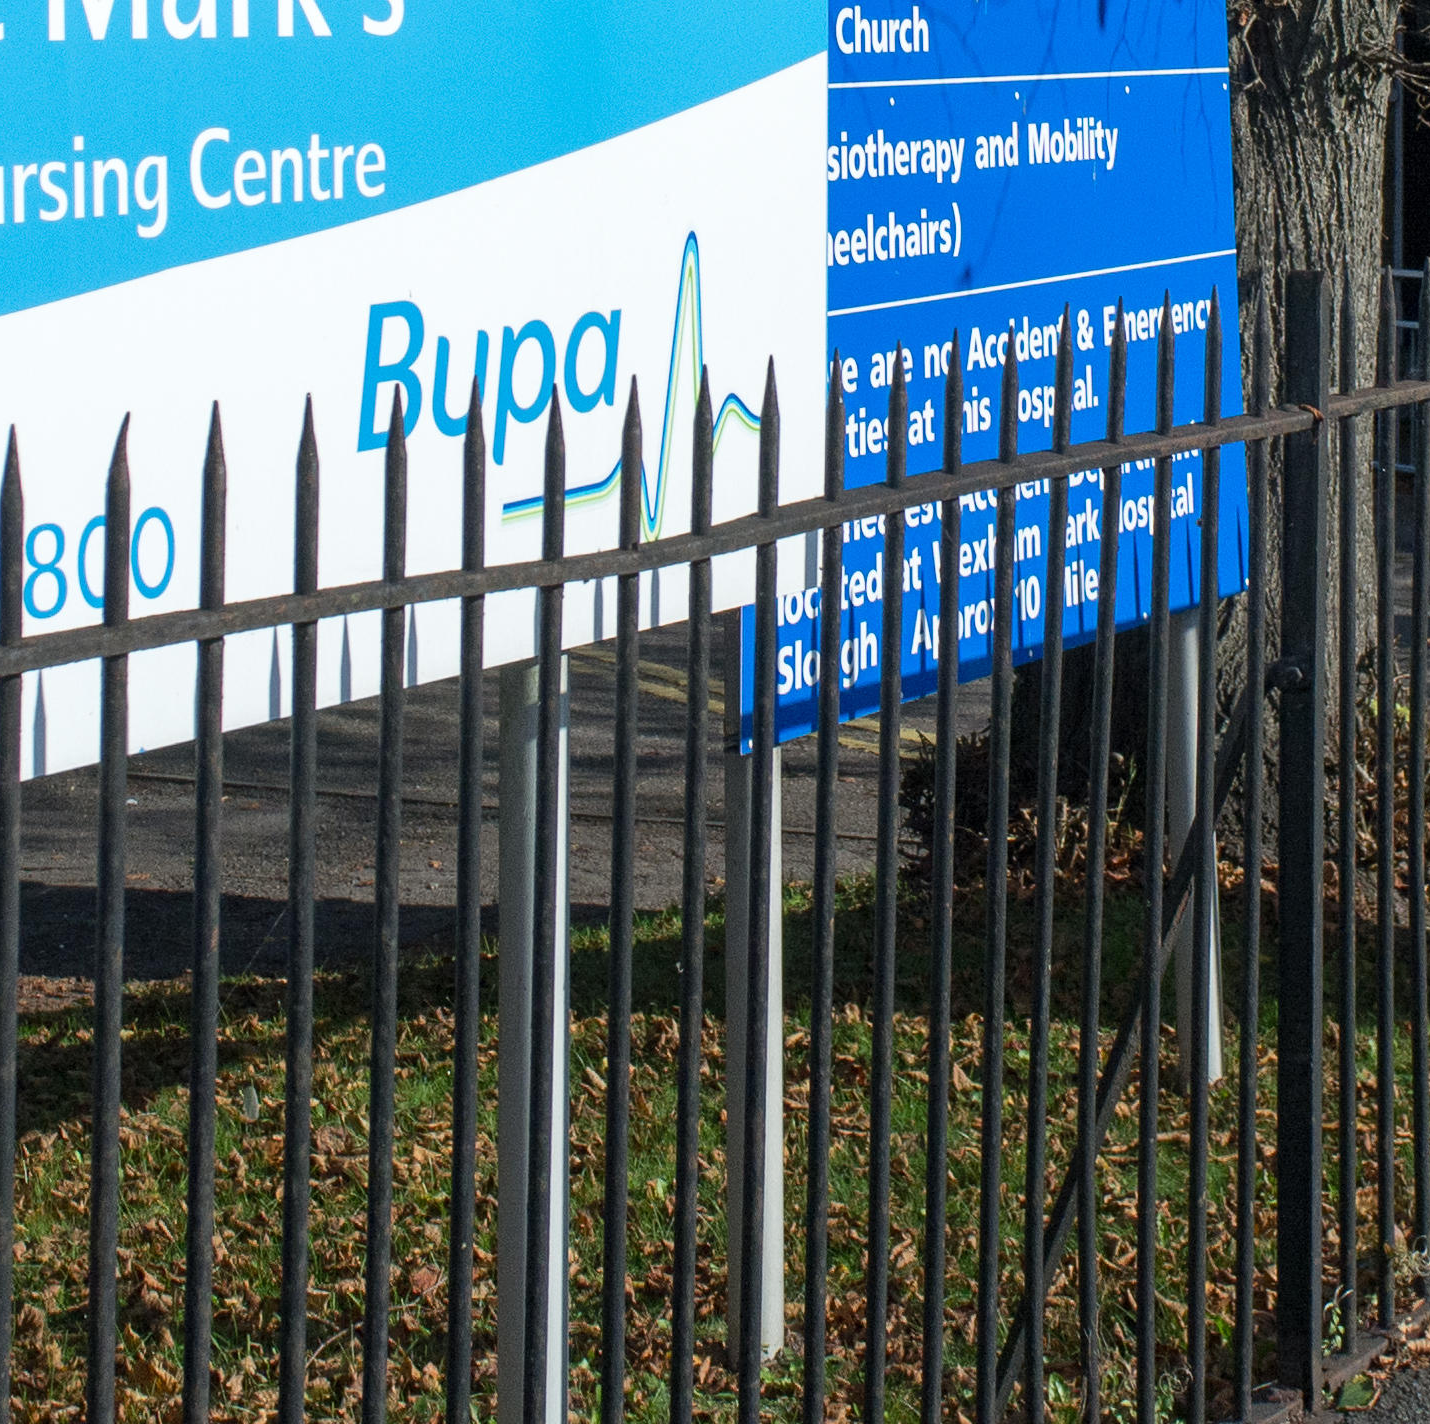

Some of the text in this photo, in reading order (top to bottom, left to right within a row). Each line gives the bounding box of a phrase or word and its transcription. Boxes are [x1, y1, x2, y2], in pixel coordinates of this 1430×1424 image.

[835, 5, 930, 54] Church
[188, 127, 387, 210] Centre
[975, 121, 1018, 170] and
[1028, 116, 1118, 171] Mobility
[966, 313, 1064, 372] Accden
[1076, 308, 1095, 352] &
[357, 300, 622, 466] Bupa
[908, 399, 936, 446] at
[960, 386, 992, 435] his
[1017, 364, 1099, 429] ospal.
[24, 506, 176, 620] 800
[777, 551, 884, 627] locted
[1065, 498, 1101, 549] ark
[777, 621, 879, 695] Slogh
